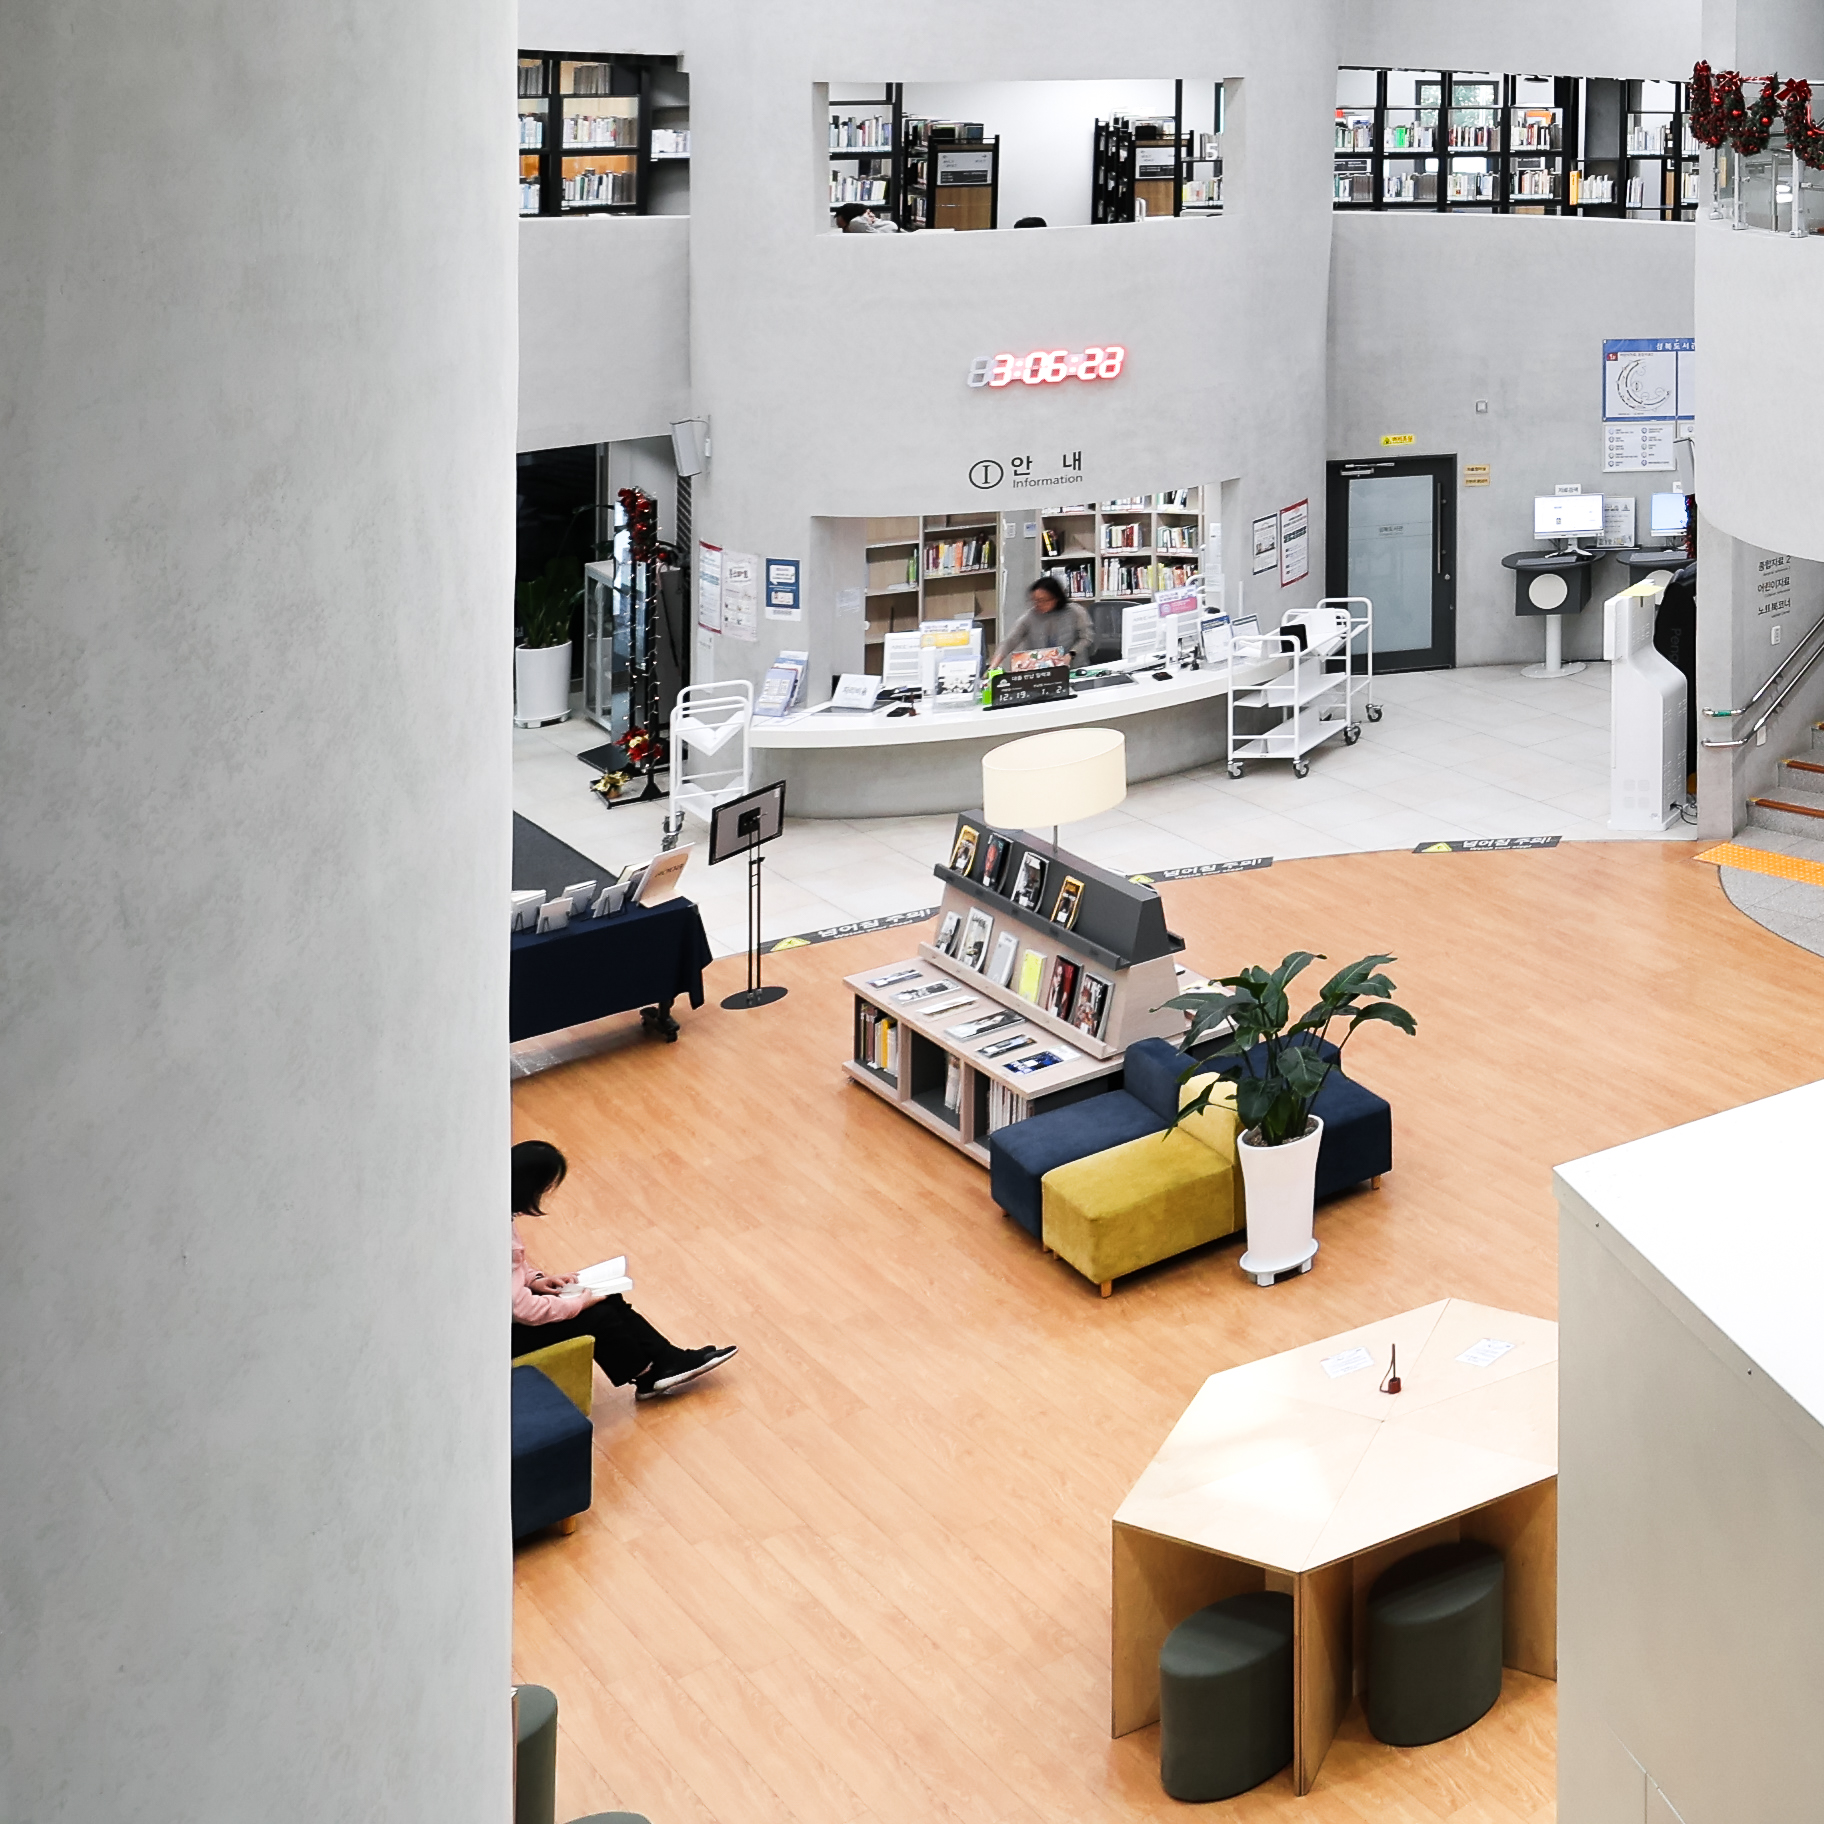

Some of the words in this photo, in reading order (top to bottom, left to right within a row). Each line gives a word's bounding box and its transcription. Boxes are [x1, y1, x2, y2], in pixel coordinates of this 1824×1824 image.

[1205, 143, 1218, 160] 5
[1012, 475, 1083, 488] Information
[1758, 556, 1784, 572] 종합자료
[1757, 576, 1790, 592] 어린이자료
[1463, 838, 1511, 848] 넘어짐
[1514, 836, 1551, 844] 주의!
[1163, 865, 1216, 878] 넘어짐
[1222, 858, 1262, 868] 주의!
[818, 919, 879, 938] 넘어짐
[885, 908, 930, 922] 주의!
